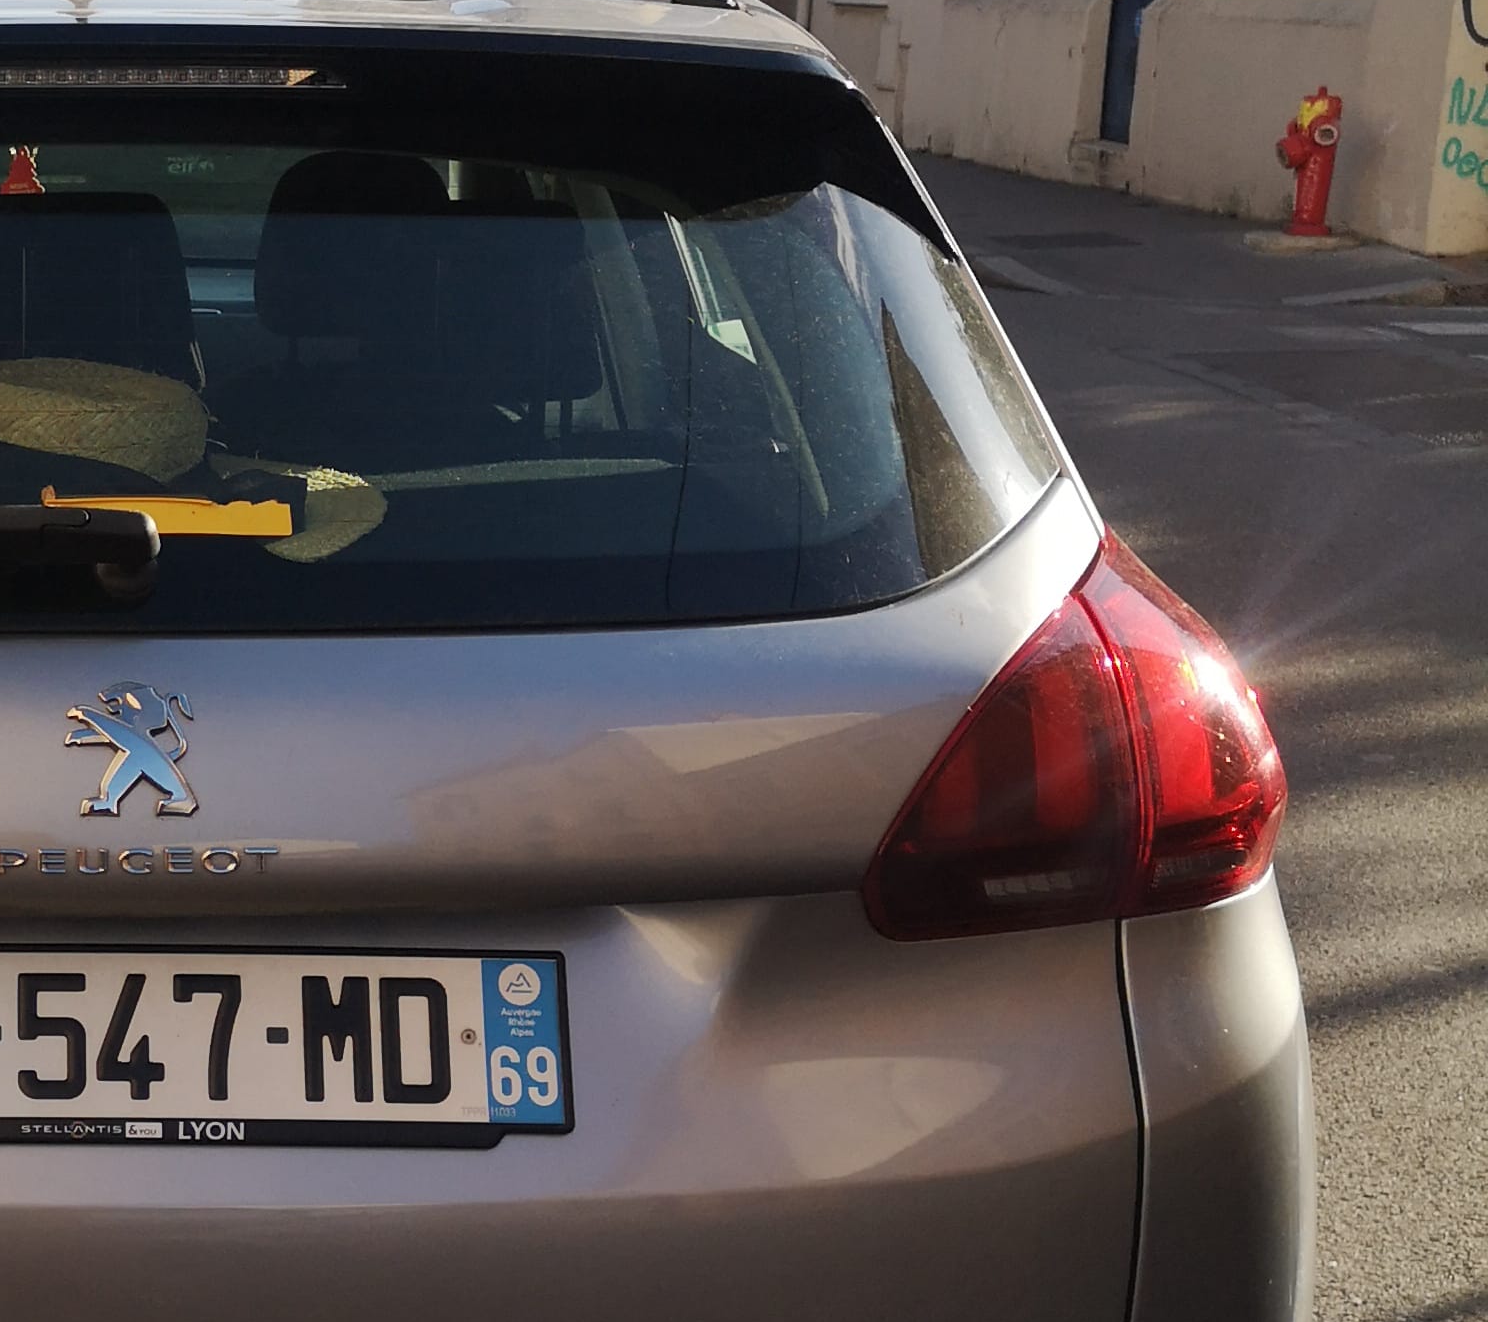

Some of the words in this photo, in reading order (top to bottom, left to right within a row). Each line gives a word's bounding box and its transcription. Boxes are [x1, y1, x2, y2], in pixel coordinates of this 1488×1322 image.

[490, 1045, 559, 1107] 69
[20, 1123, 123, 1136] STELLANTIS
[178, 1121, 245, 1141] LYON
